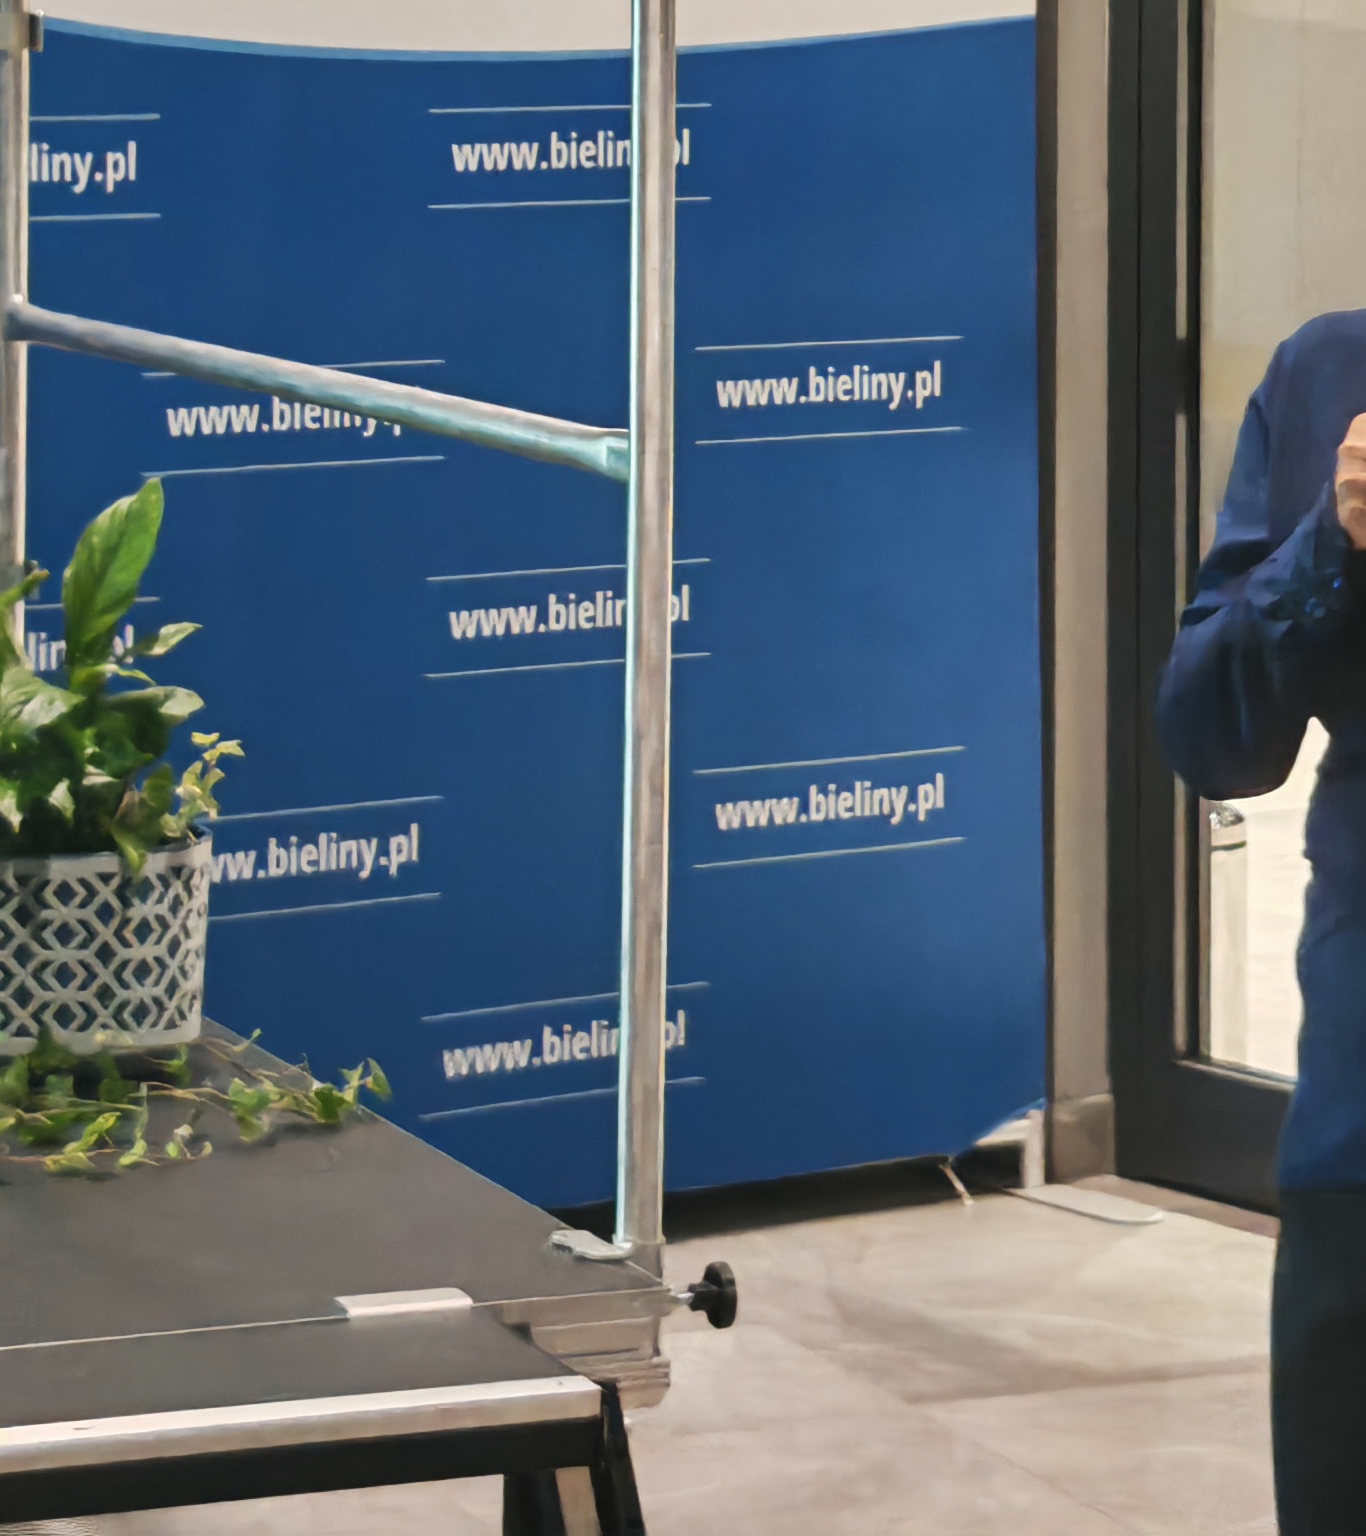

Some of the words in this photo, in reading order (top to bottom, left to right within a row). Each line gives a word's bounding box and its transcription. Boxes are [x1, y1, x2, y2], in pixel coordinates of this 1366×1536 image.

[451, 128, 691, 172] www.bielinl
[715, 360, 942, 411] www.bieliny.pl
[715, 772, 945, 831] www.bieliny.pl
[210, 822, 420, 883] w.bieliny.pl
